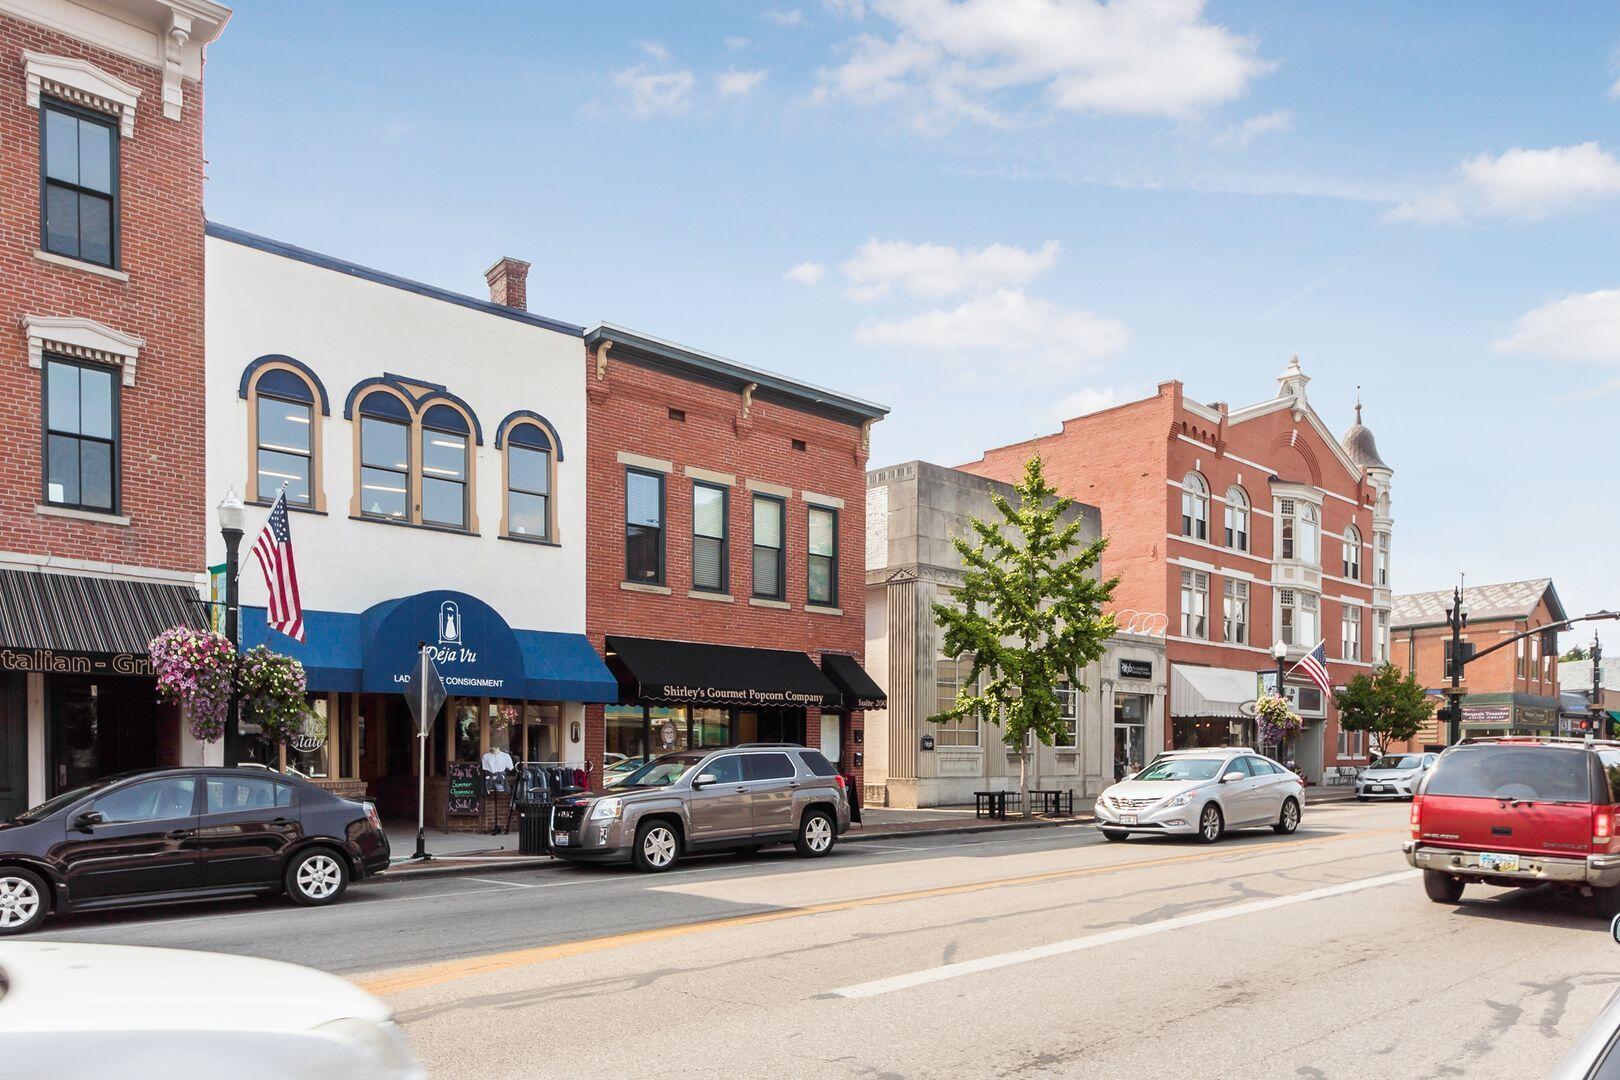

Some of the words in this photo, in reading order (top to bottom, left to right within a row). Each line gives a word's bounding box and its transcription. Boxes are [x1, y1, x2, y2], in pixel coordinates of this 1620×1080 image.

[1, 649, 91, 672] talian
[112, 653, 162, 675] Gri
[459, 648, 477, 663] Vu
[394, 675, 411, 683] LAD
[445, 677, 504, 687] CONSIGNMENT
[663, 685, 706, 700] Shirley's
[706, 687, 747, 699] Gourmet
[749, 689, 784, 703] Popcorn
[785, 690, 824, 705] Company
[858, 698, 875, 707] Suite
[451, 780, 472, 788] Summer
